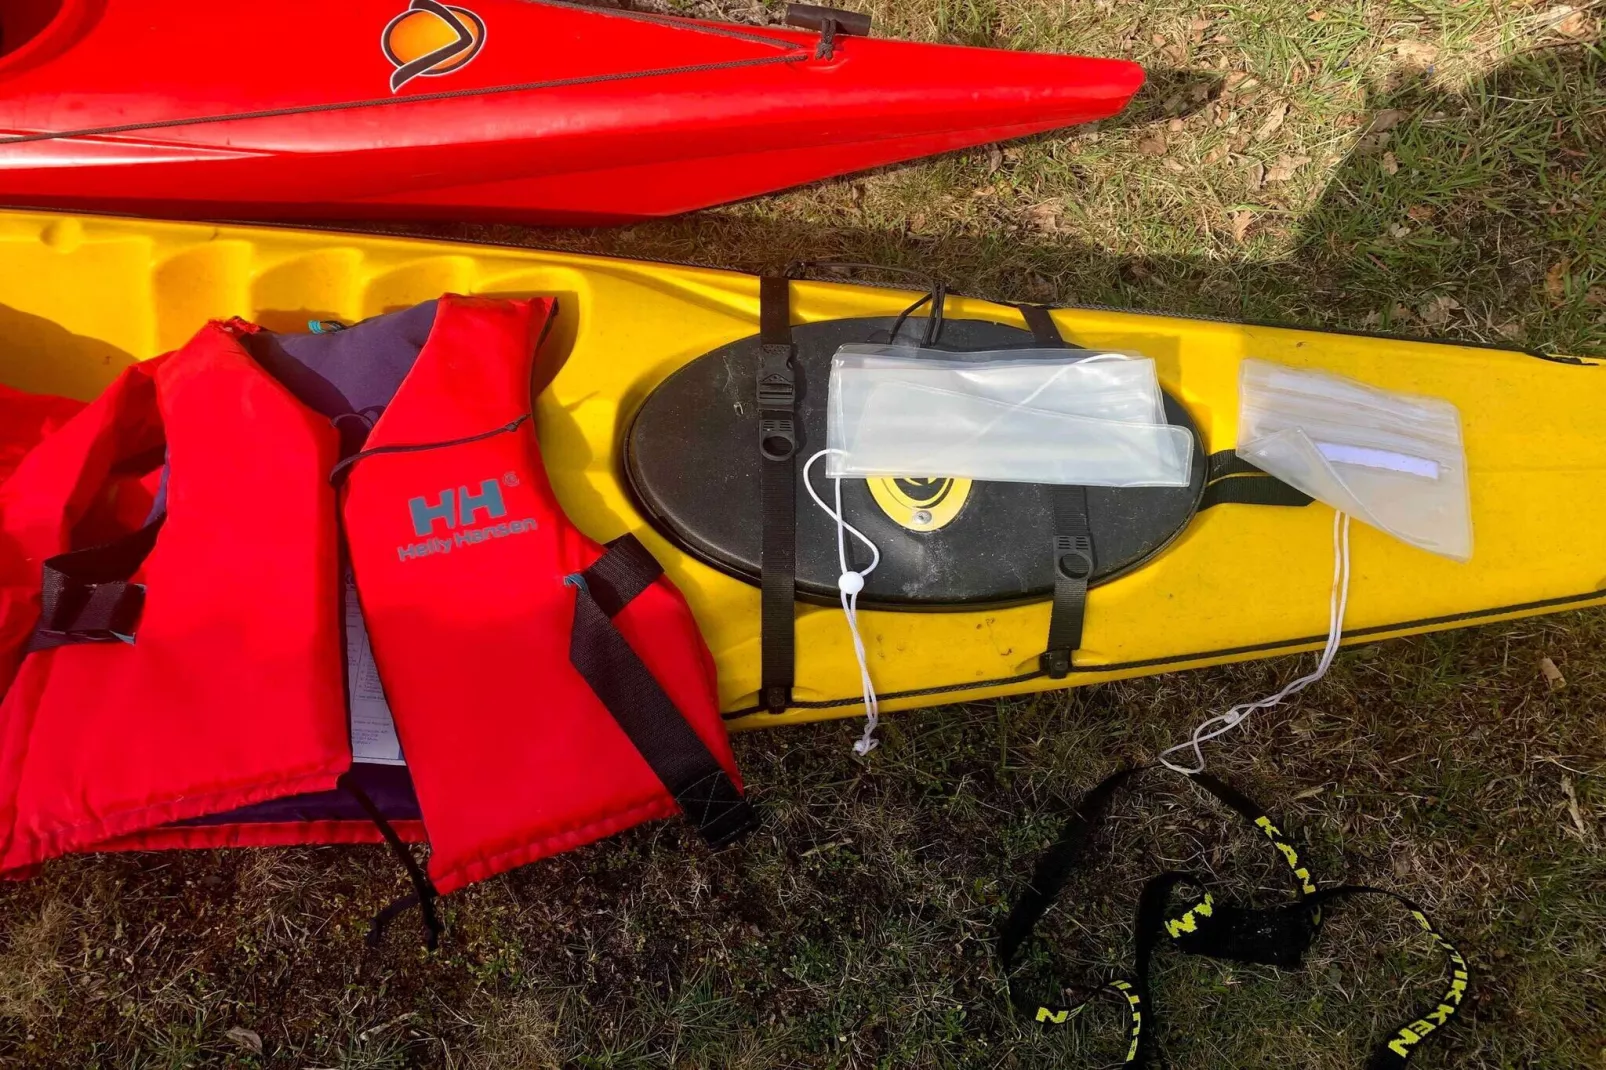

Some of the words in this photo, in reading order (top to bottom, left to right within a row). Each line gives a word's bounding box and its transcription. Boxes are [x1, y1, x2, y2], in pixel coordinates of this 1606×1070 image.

[408, 478, 506, 537] HH
[397, 537, 452, 561] Helly
[453, 517, 537, 547] Hansen
